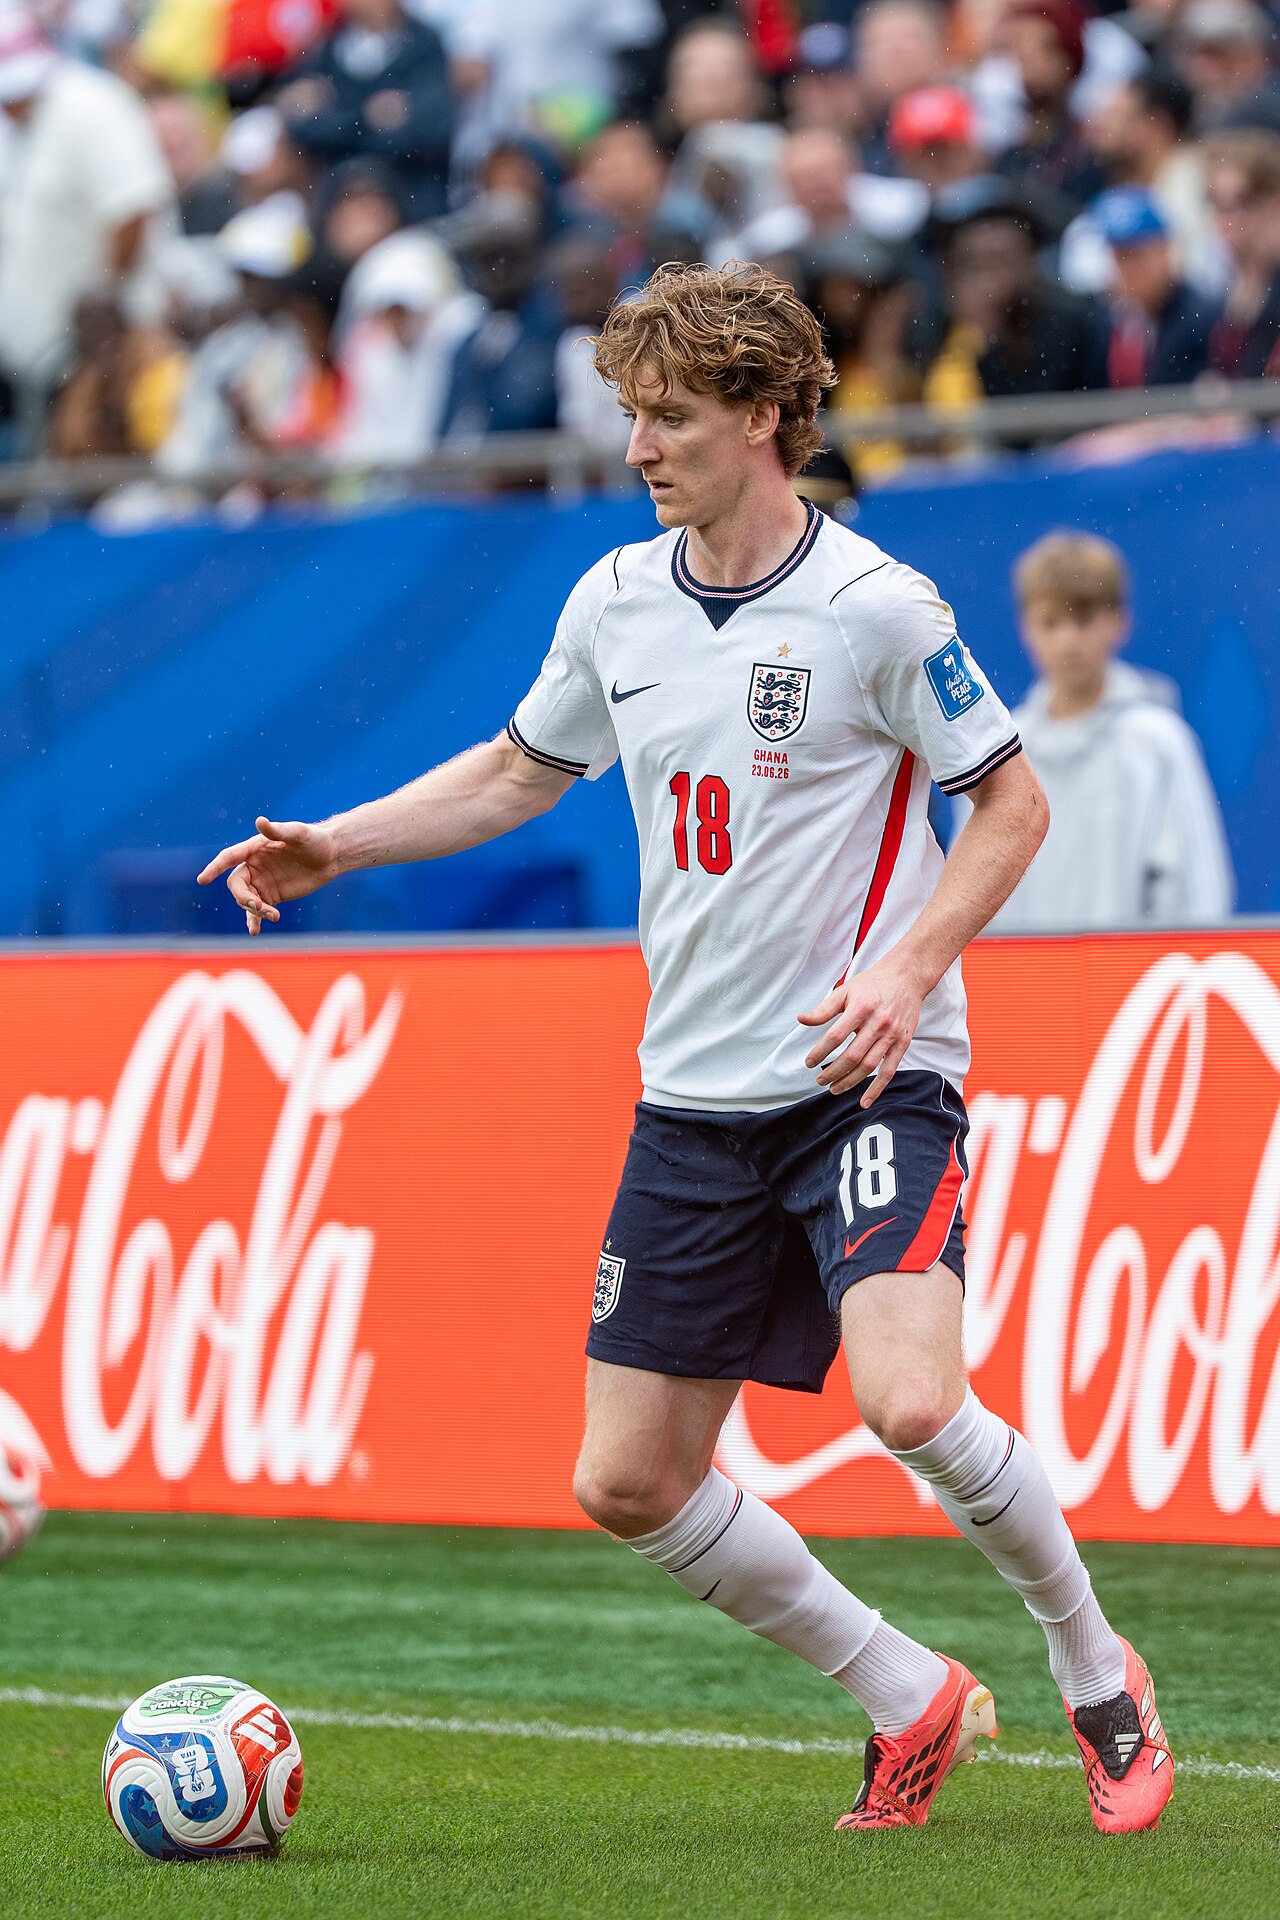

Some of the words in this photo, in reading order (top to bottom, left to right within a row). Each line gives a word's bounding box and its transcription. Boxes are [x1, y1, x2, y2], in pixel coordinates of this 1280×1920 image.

[753, 749, 789, 765] GHANA
[751, 764, 789, 780] 23.06.26
[669, 771, 733, 876] 18
[837, 1121, 899, 1229] 18
[149, 1699, 209, 1711] TRIONDA
[180, 1749, 197, 1759] FIFA
